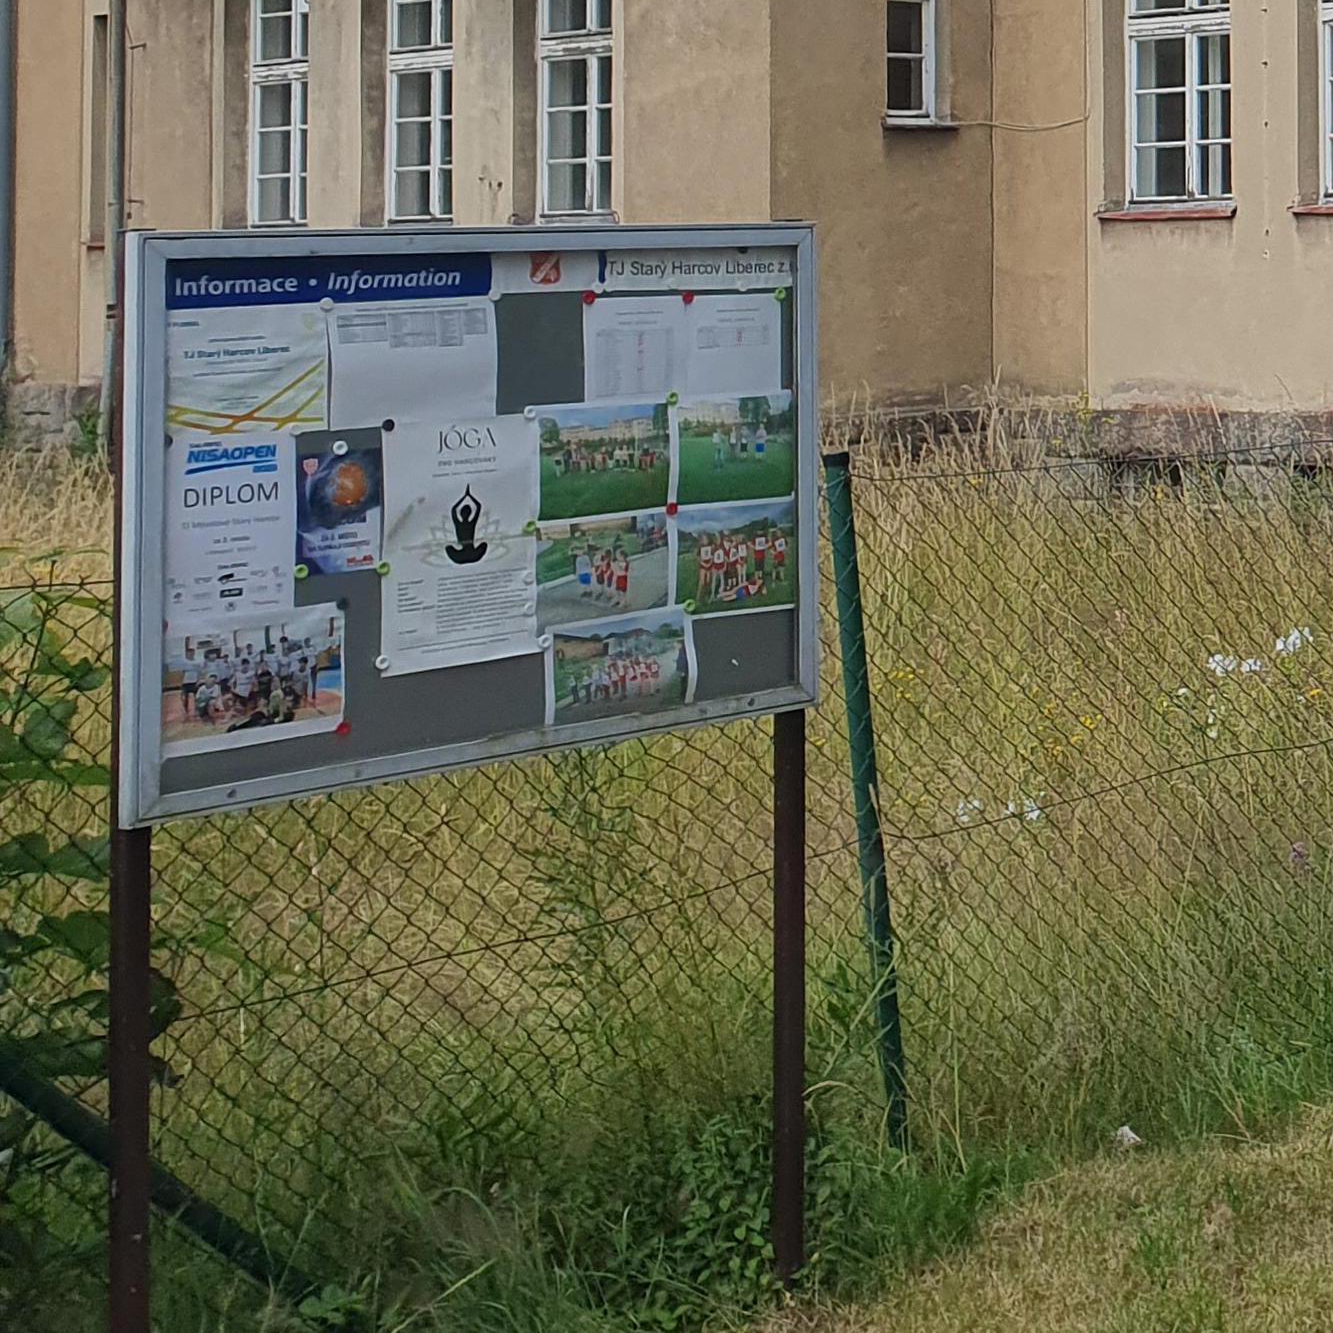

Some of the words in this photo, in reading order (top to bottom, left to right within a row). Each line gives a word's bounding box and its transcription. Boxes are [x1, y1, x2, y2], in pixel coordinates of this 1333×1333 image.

[174, 274, 299, 296] Informace
[327, 268, 461, 294] Information
[609, 262, 625, 276] TJ
[630, 261, 667, 278] Starý
[671, 261, 721, 275] Harcov
[725, 261, 775, 275] Liberec
[438, 424, 497, 454] JÓGA
[183, 481, 279, 508] DIPLOM
